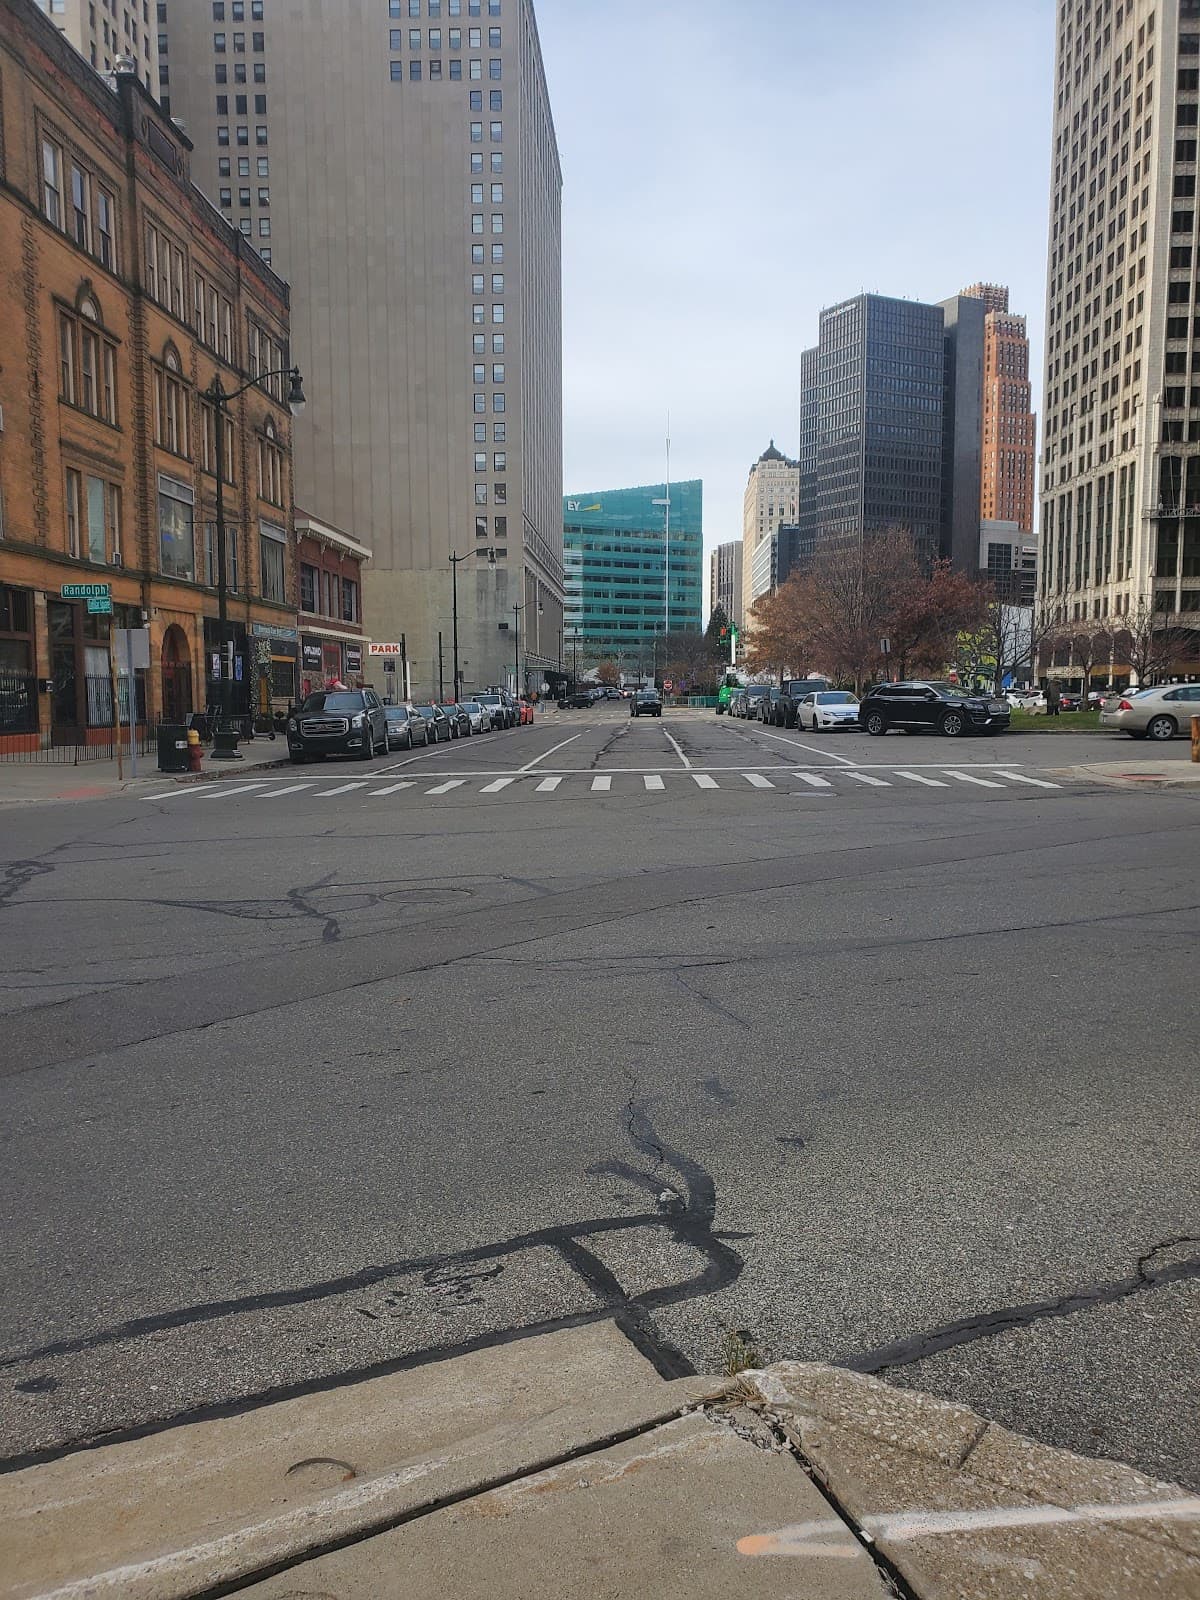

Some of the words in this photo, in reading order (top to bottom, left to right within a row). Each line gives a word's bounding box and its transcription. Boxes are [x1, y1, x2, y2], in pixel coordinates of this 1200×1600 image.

[567, 500, 580, 511] EY
[63, 585, 106, 597] Randolph
[371, 645, 399, 653] PARK
